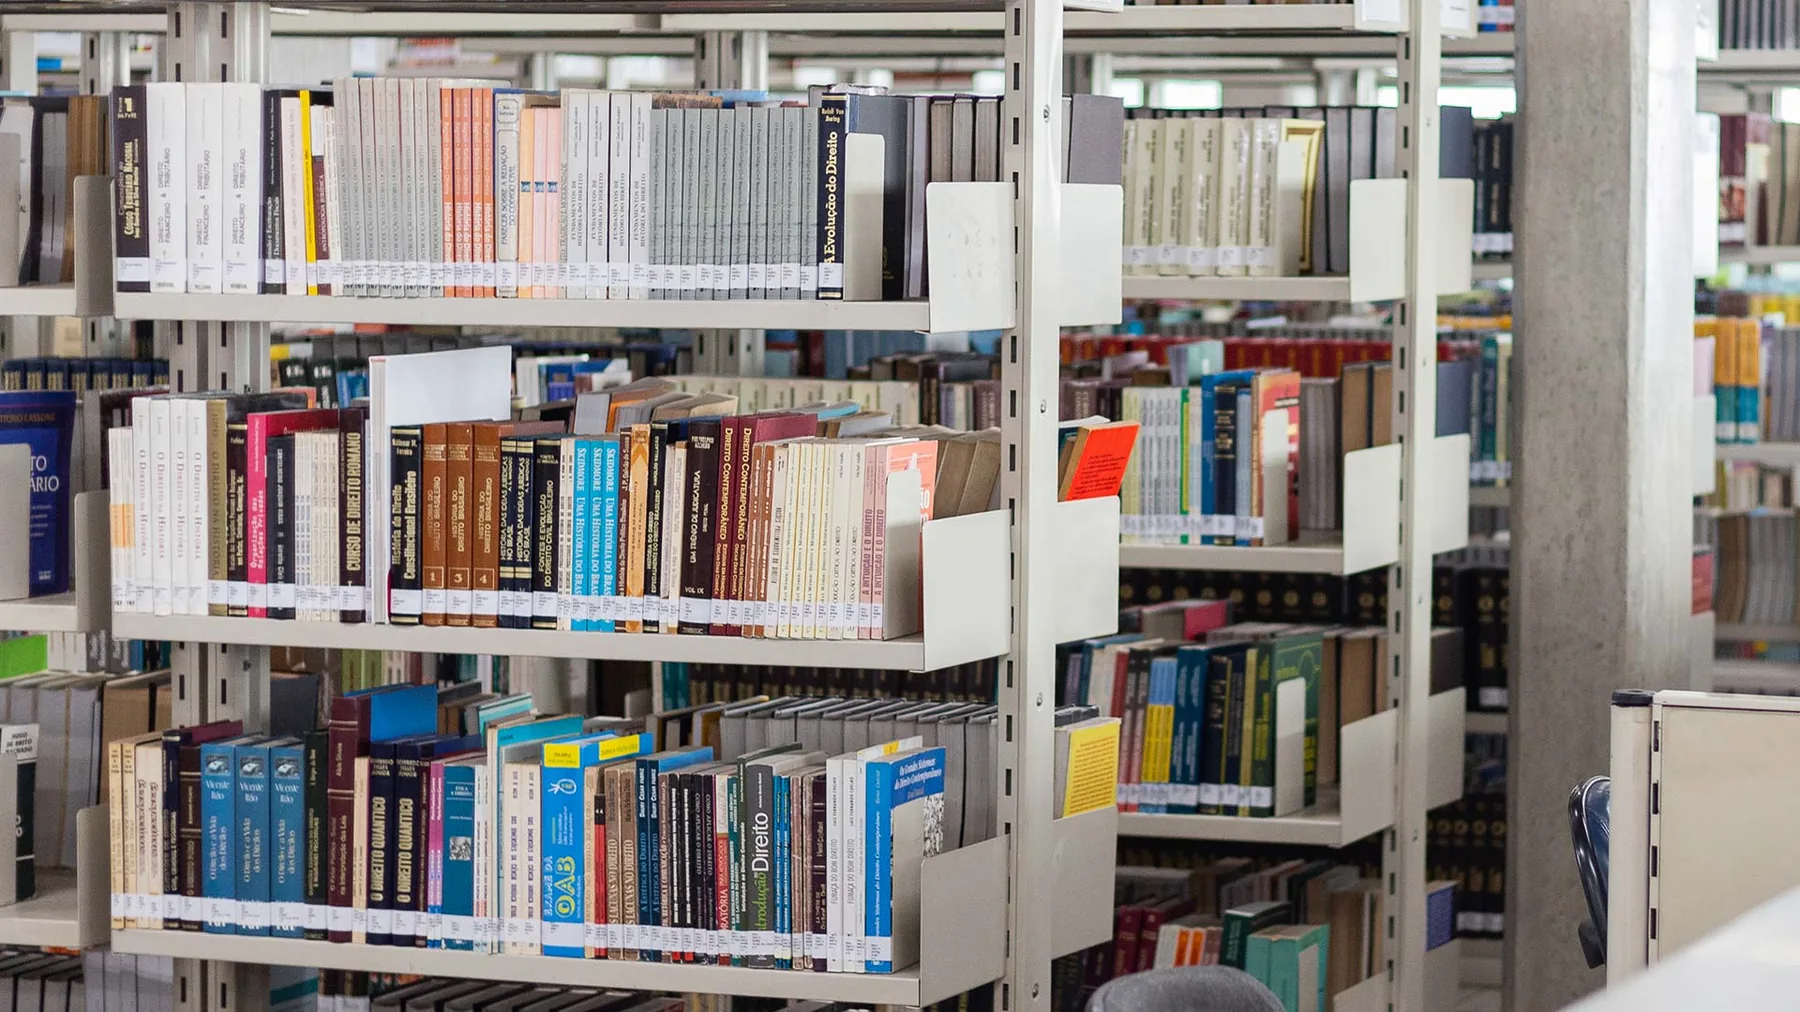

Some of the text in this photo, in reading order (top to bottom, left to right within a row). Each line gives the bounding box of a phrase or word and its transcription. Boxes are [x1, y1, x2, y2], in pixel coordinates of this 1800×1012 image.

[202, 150, 210, 190] TRIBUTÁRIO
[824, 131, 838, 264] A Evolução do Direito
[576, 448, 587, 491] SKIDMORE
[719, 428, 733, 541] DIREITO CONTEMPORÂNEO
[346, 432, 361, 571] CURSO DE DIREITO ROMANO
[452, 490, 458, 501] DO
[479, 491, 485, 502] DO
[546, 480, 554, 524] BRASILEIRO
[576, 497, 585, 517] UMA
[692, 471, 701, 513] JUDICATURA
[392, 484, 402, 564] História do Direito
[404, 471, 416, 579] Constitucional Brasileiro
[539, 494, 547, 533] EVOLUÇÃO
[692, 514, 698, 523] DE
[865, 509, 873, 537] DIREITO
[500, 529, 508, 560] HISTÓRIA
[545, 525, 553, 543] CIVIL
[575, 519, 586, 558] HISTÓRIA
[507, 549, 513, 560] NO
[575, 560, 583, 572] DO
[689, 552, 697, 563] UM
[862, 553, 872, 587] INTUIÇÃO
[454, 573, 462, 583] 3
[545, 576, 552, 587] DO
[372, 796, 386, 901] O DIREITO QUANTICO
[751, 812, 769, 871] Direito
[544, 855, 553, 916] EXAME DA
[554, 856, 576, 918] OAB
[608, 839, 618, 918] LACUNAS NO DIREITO
[830, 838, 839, 904] FUMAÇA DO BOM DIREITO
[752, 872, 771, 929] trodução
